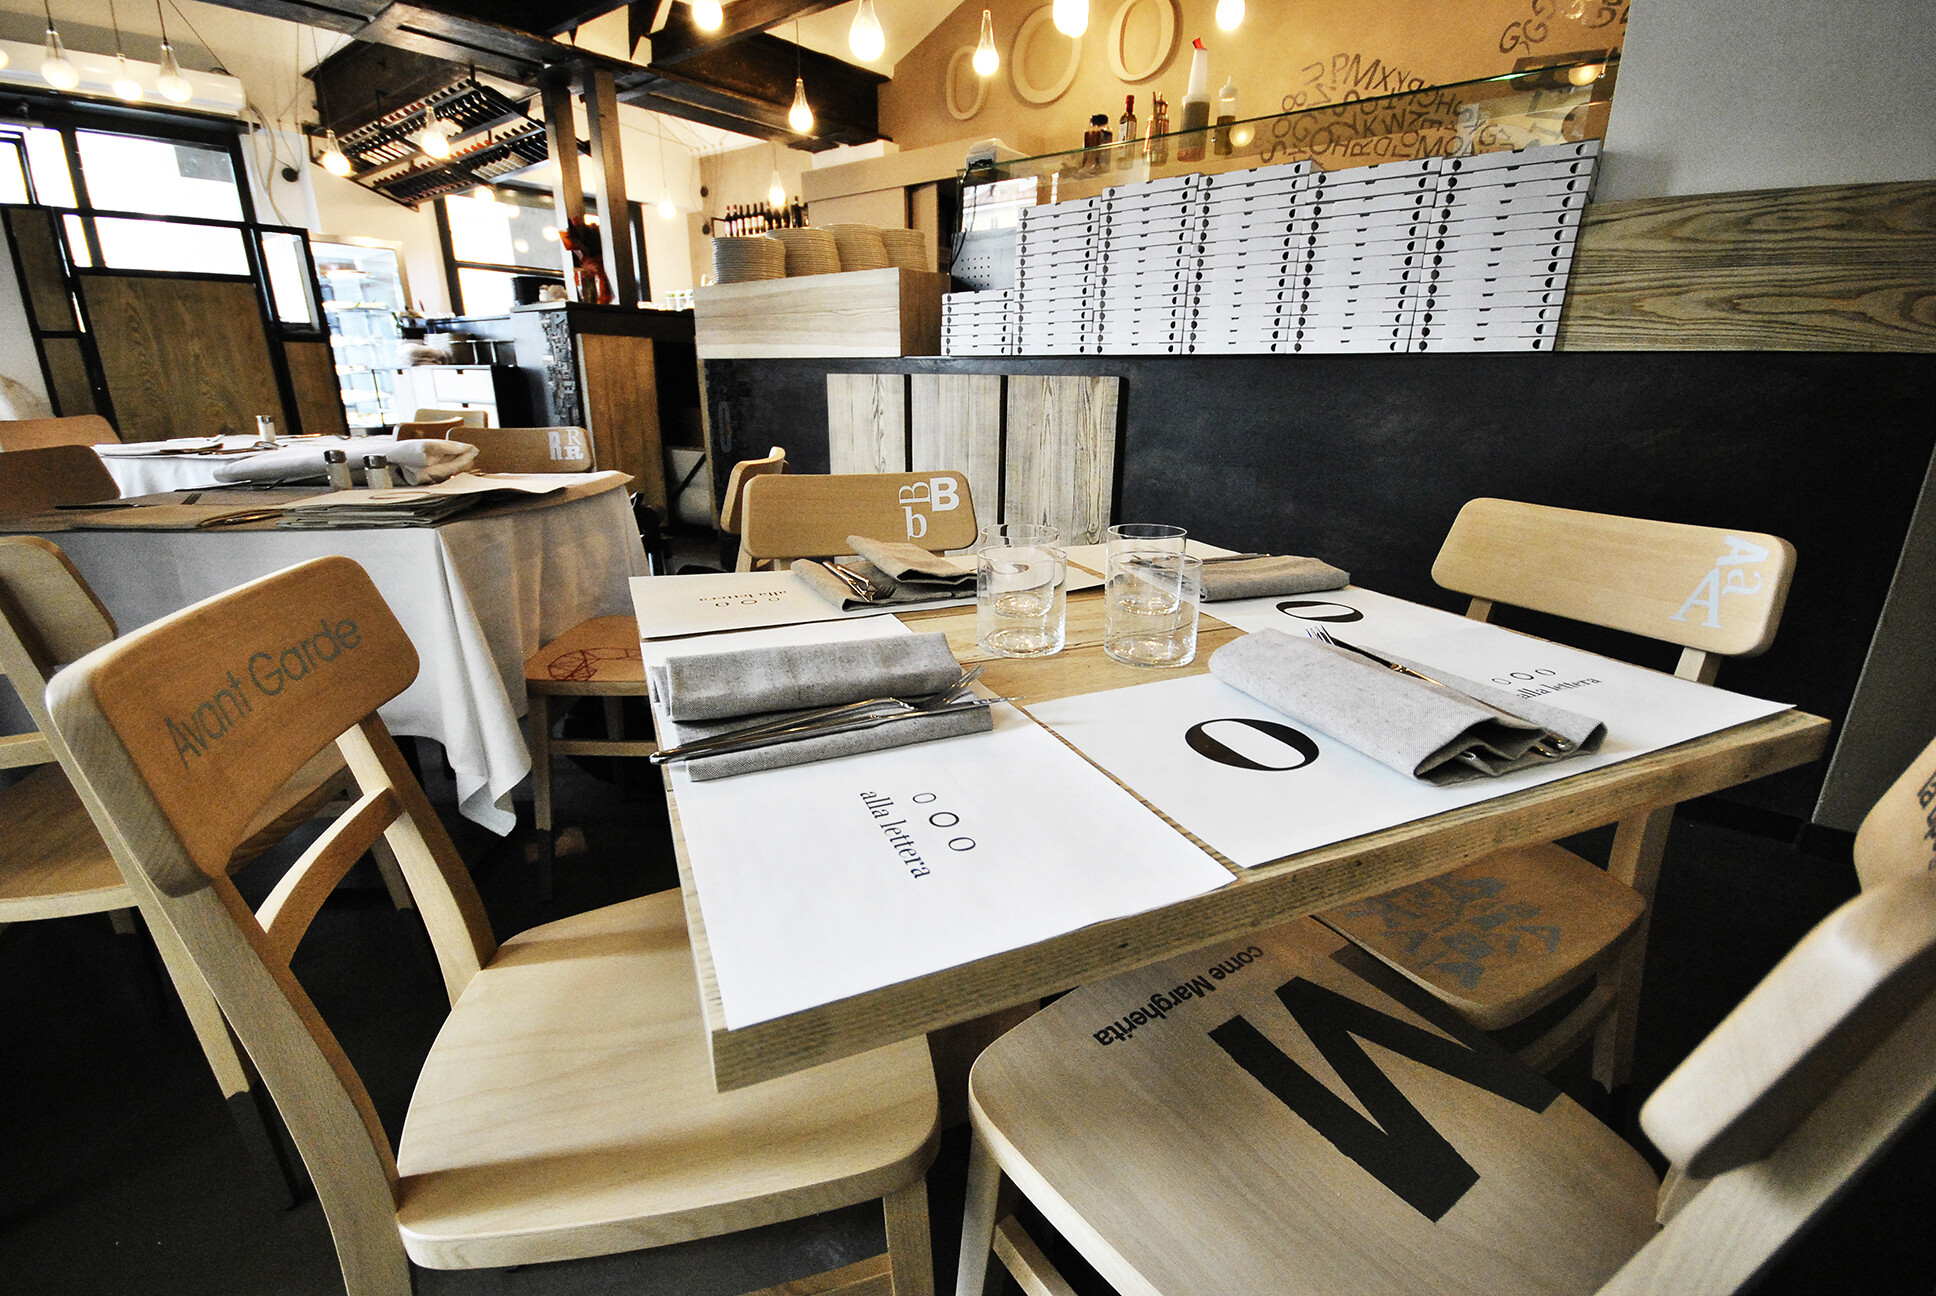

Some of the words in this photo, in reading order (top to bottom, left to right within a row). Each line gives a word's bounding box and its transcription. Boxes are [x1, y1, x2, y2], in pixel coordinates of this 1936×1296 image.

[164, 670, 253, 770] Avant
[249, 618, 361, 696] Garde
[859, 790, 894, 819] alla
[879, 818, 931, 879] lettera
[1208, 945, 1264, 980] come
[1092, 974, 1217, 1046] Margherita
[1207, 943, 1565, 1224] M
